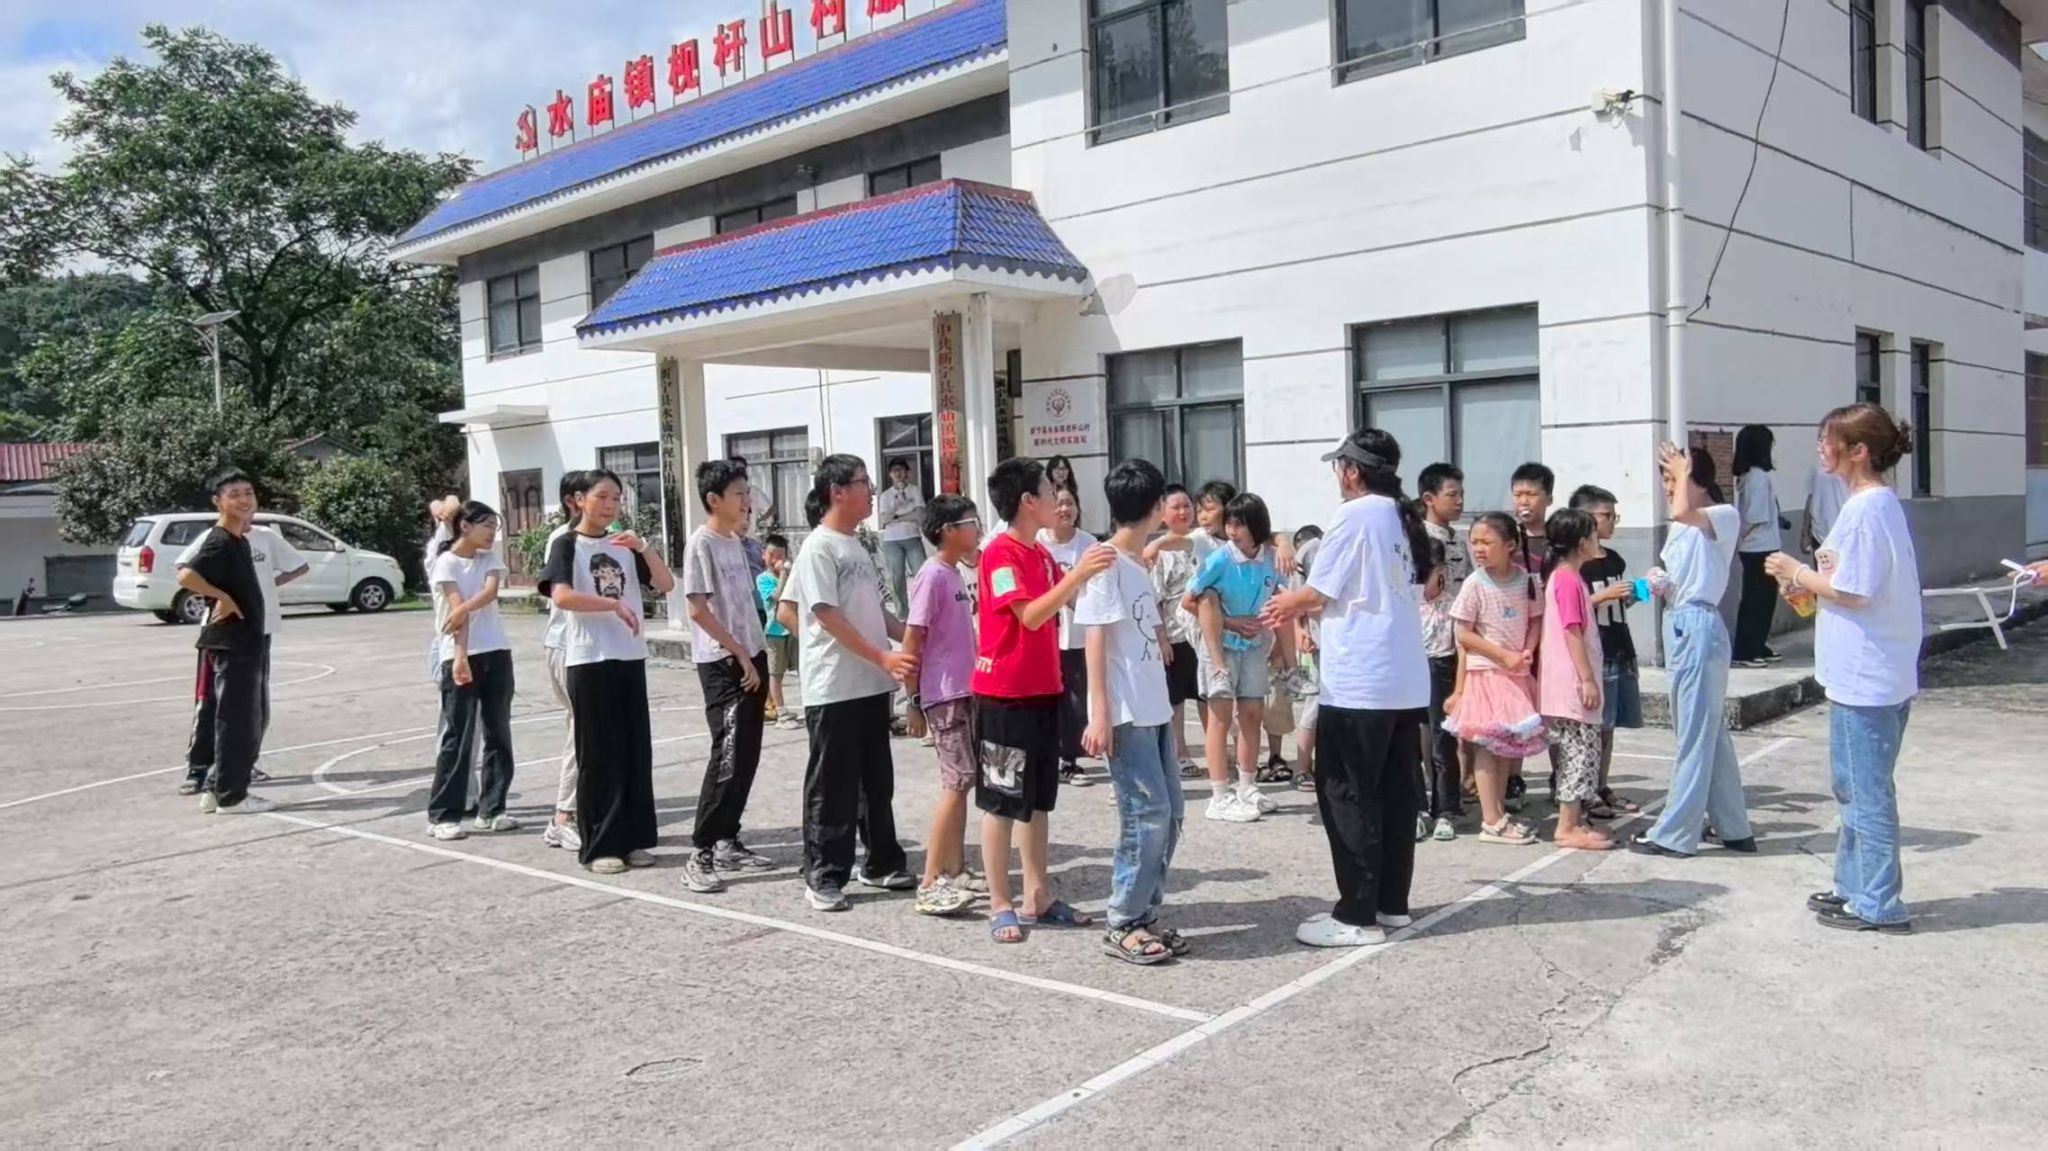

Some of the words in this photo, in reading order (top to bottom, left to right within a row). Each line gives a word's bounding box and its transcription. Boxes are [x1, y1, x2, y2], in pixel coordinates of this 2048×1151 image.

[515, 0, 905, 152] 水庙镇枧杆山村
